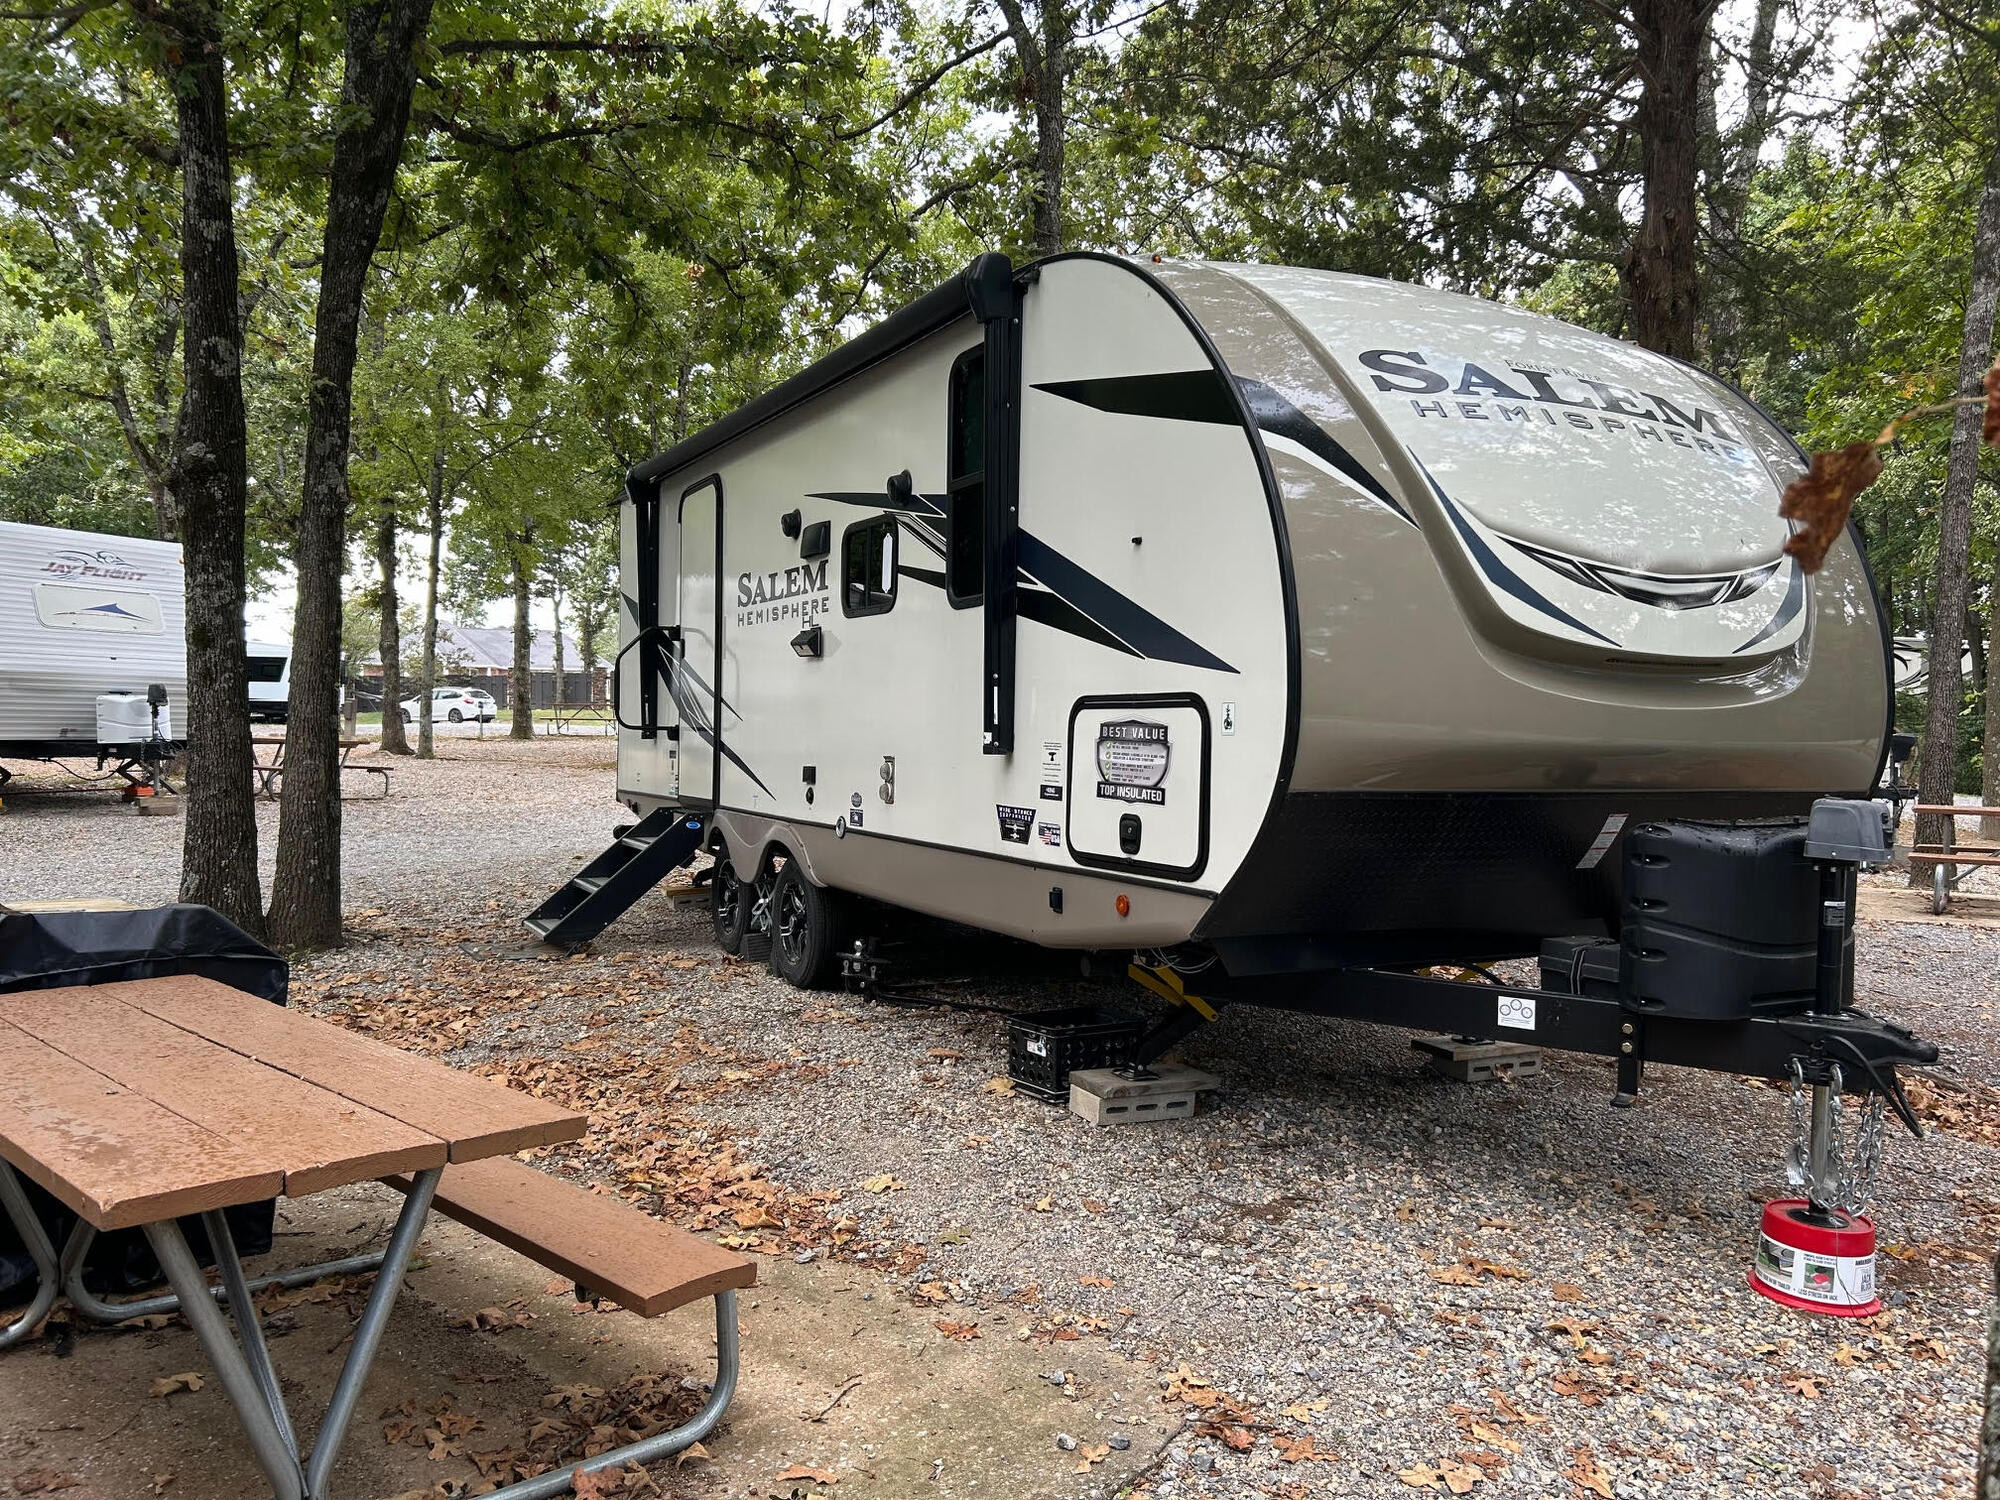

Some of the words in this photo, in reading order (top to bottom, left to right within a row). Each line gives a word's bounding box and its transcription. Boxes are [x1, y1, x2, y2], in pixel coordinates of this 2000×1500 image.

[1359, 350, 1742, 445] SALEM
[1410, 400, 1745, 463] HEMISPHERE
[40, 561, 79, 575] JAY
[81, 565, 148, 581] FLIGHT
[738, 559, 829, 607] SALEM
[737, 596, 829, 628] HEMISPHERE
[1102, 726, 1127, 738] BEST
[1132, 727, 1165, 740] VALUE
[1100, 784, 1115, 796] TOP
[1117, 786, 1163, 802] INSULATED
